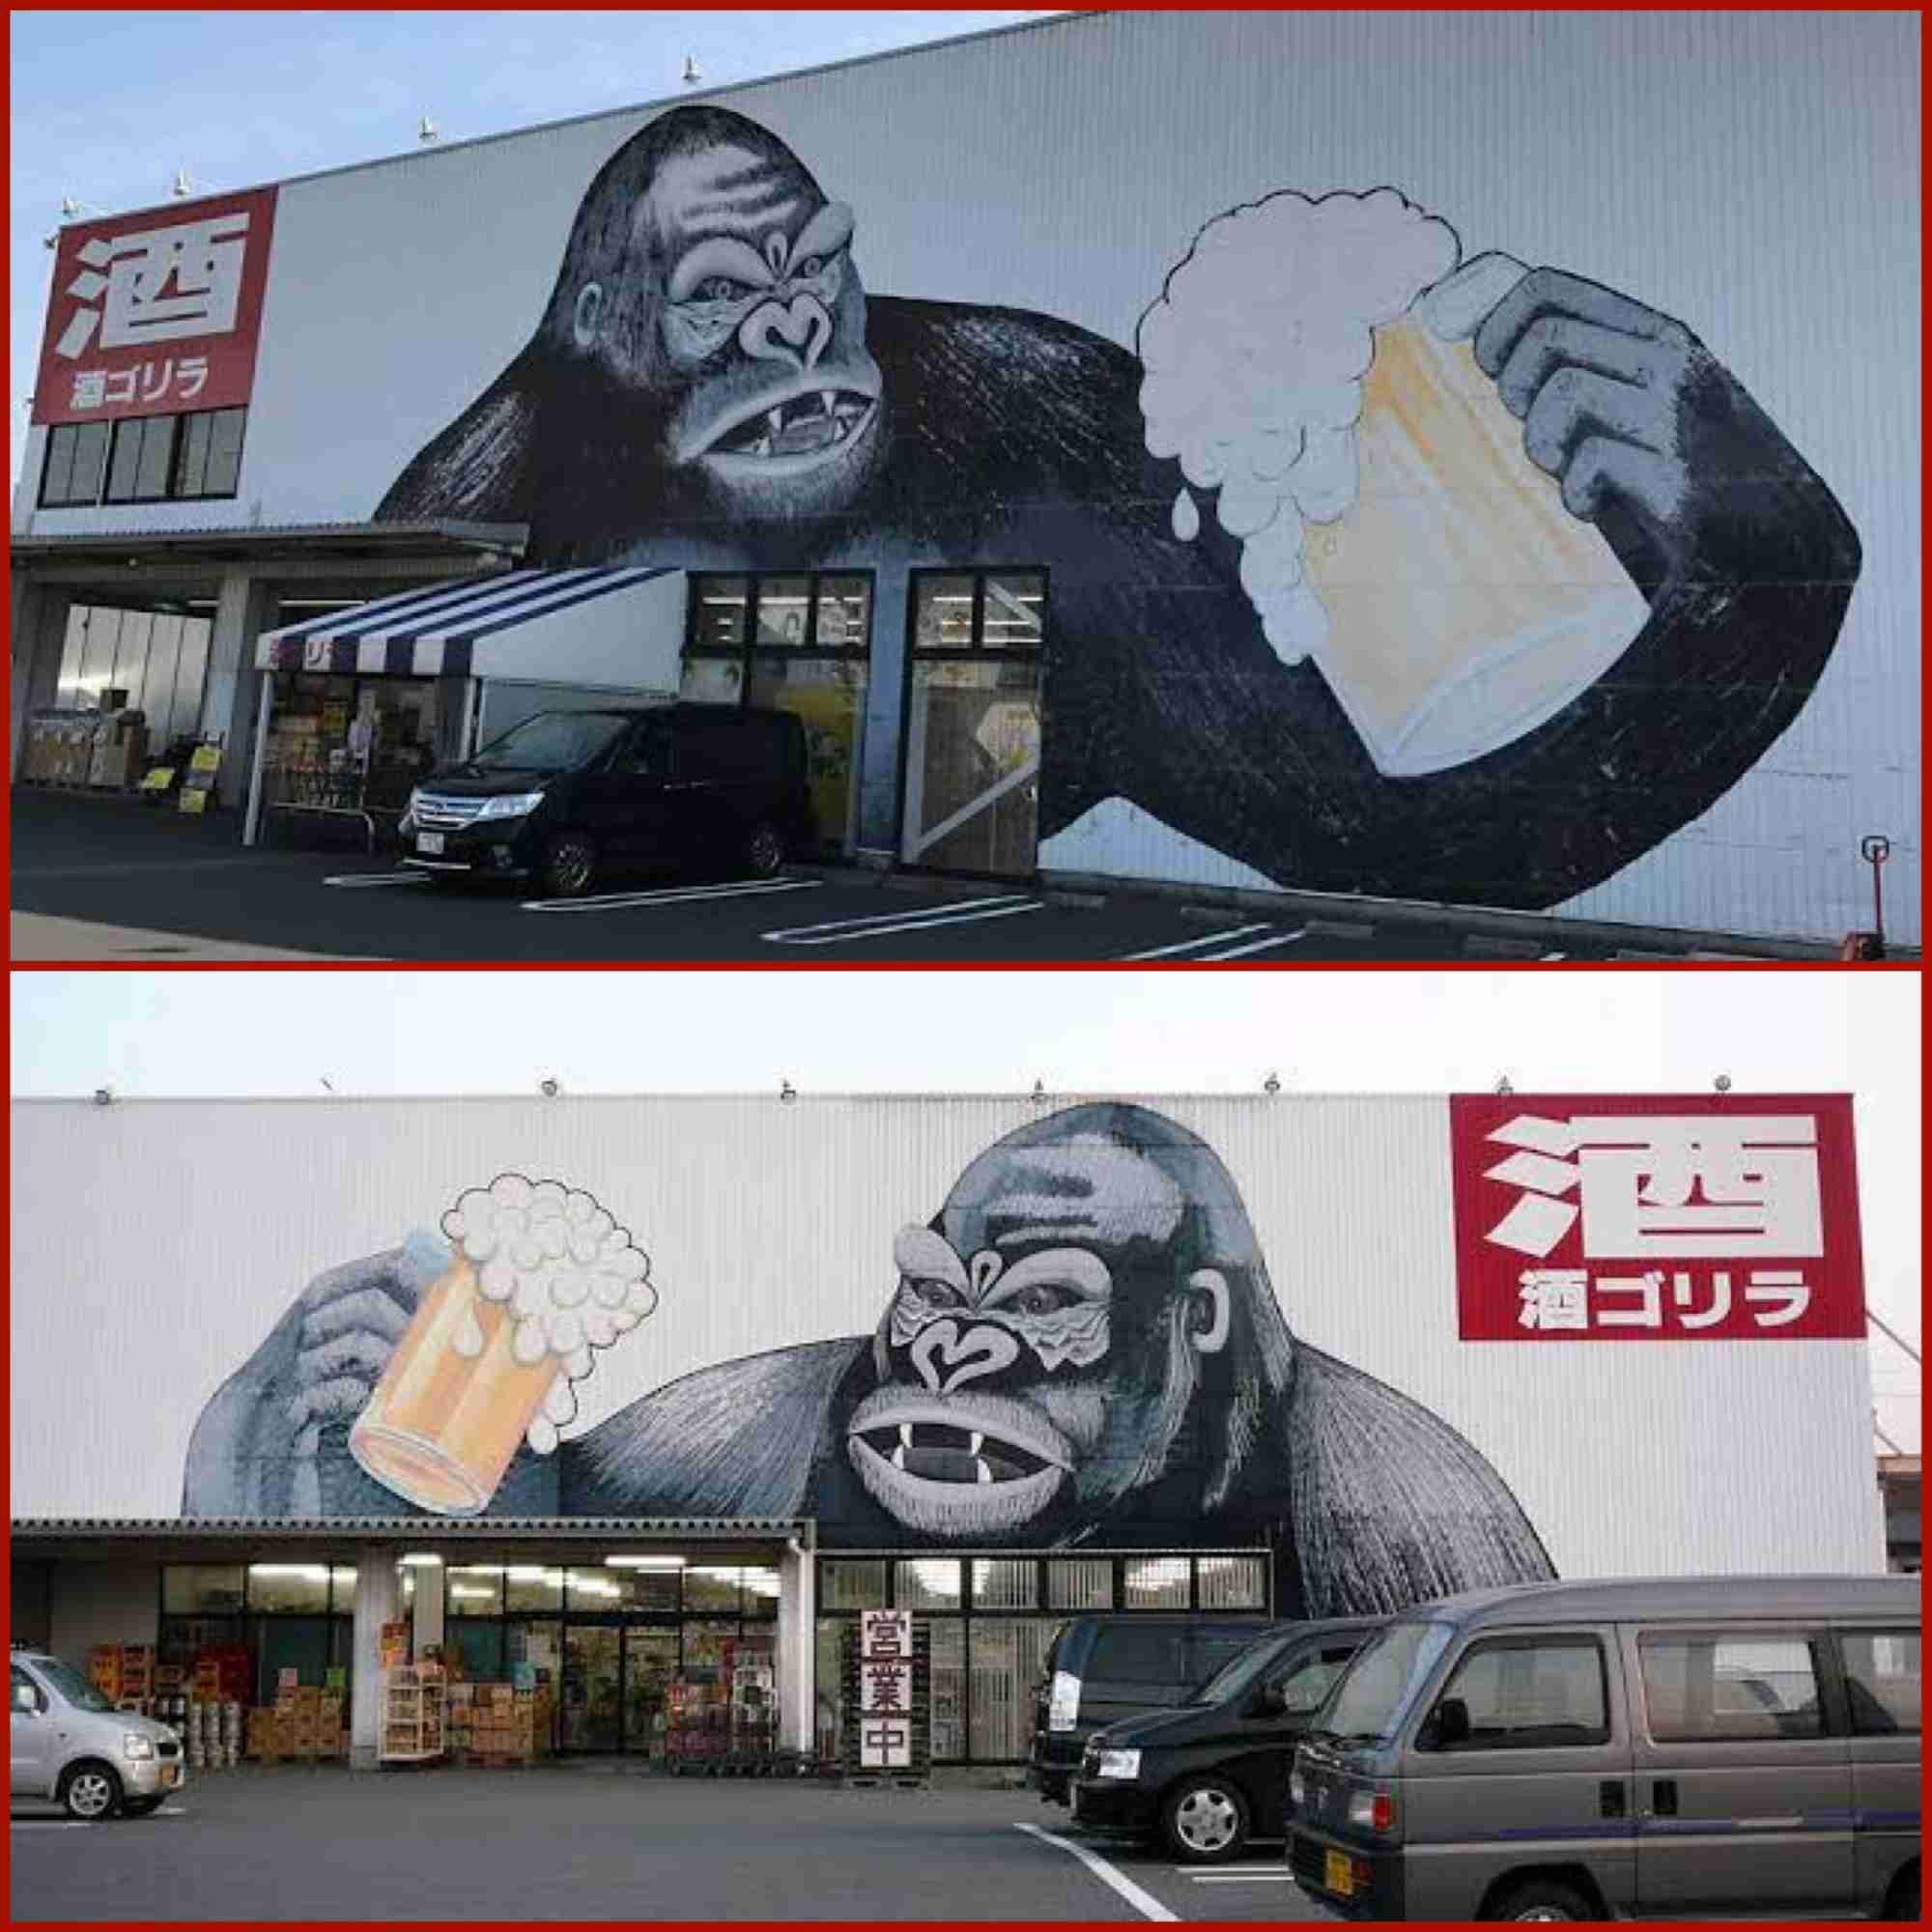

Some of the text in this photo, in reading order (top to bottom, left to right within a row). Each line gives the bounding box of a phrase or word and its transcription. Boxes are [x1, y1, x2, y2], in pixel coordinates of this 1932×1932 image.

[55, 212, 250, 360] 酒
[70, 356, 208, 410] 酒ゴリラ
[1482, 1114, 1825, 1258] 酒
[1518, 1268, 1811, 1329] 酒ゴリラ
[867, 1609, 906, 1765] 営業中
